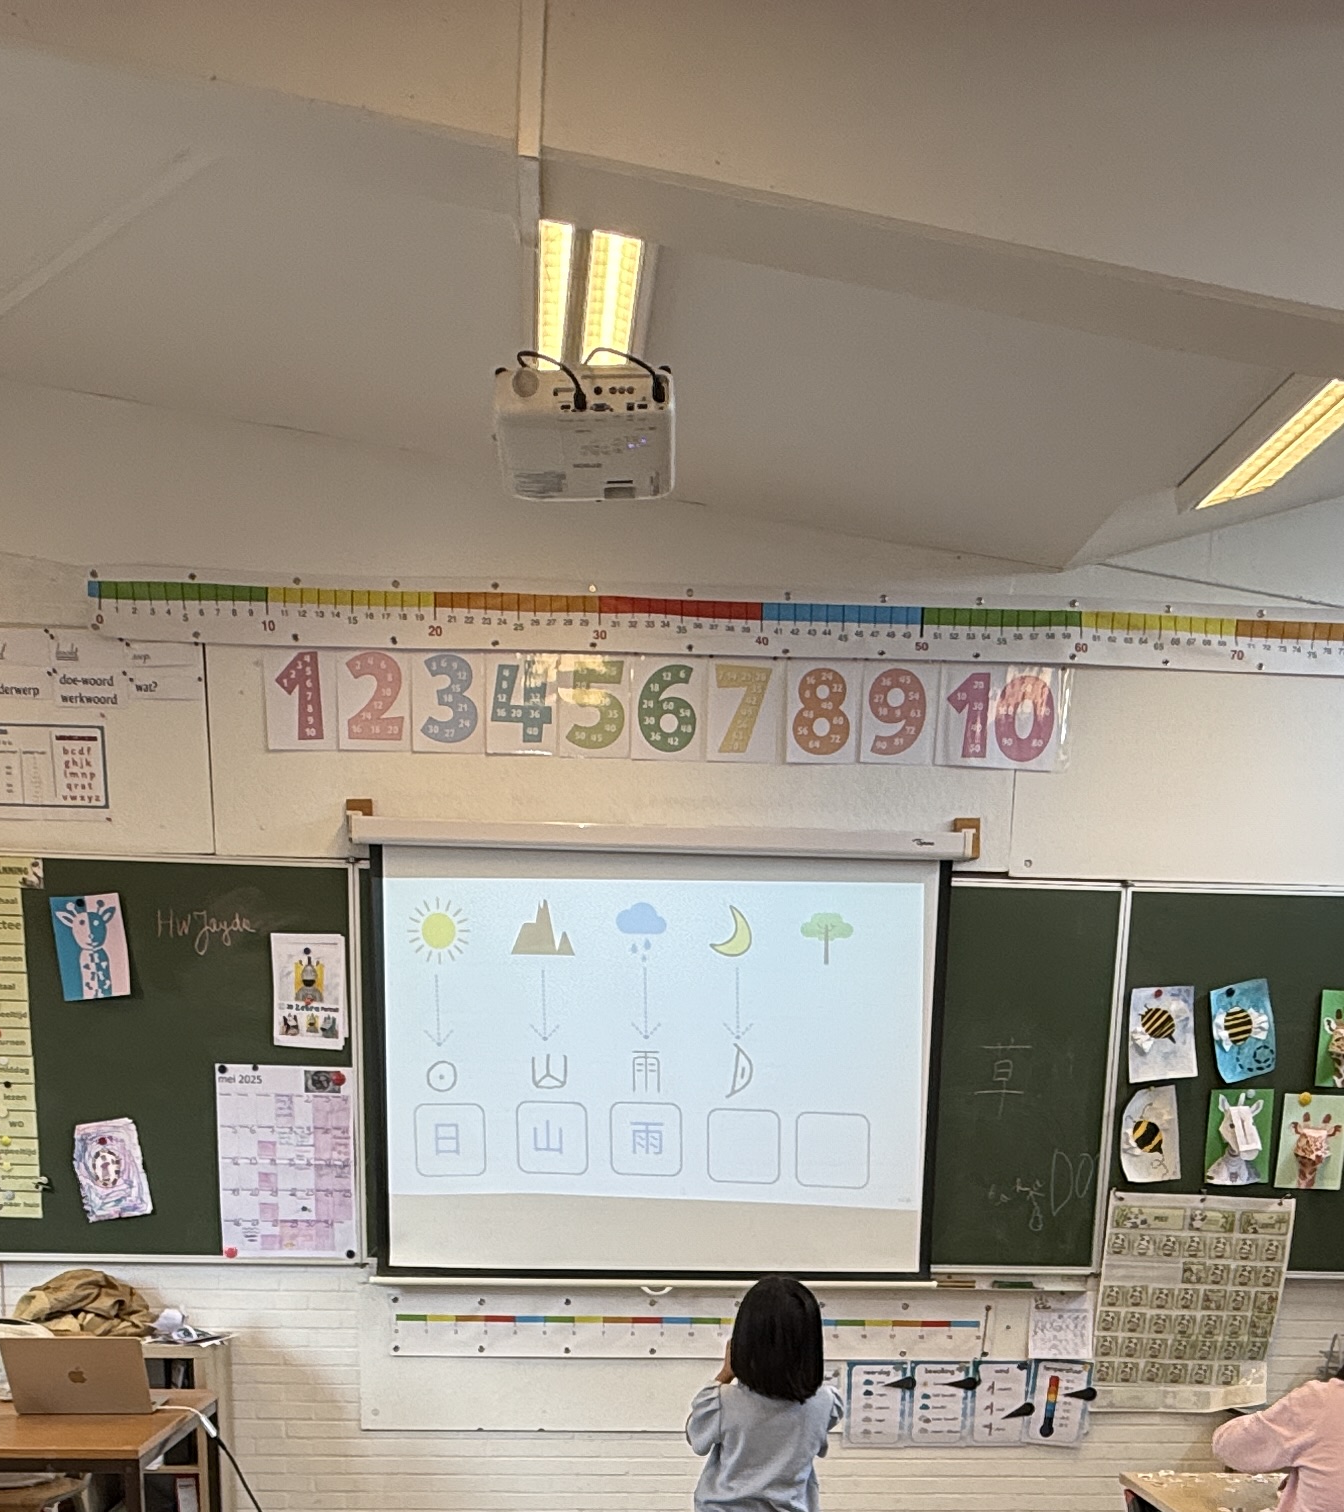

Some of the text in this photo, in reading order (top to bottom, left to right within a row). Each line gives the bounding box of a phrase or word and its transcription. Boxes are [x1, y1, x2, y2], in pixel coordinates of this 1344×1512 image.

[96, 614, 104, 624] 0
[182, 613, 189, 622] 5
[261, 620, 276, 632] 10
[347, 616, 358, 625] 15
[428, 625, 443, 636] 20
[592, 630, 607, 640] 30
[755, 636, 769, 646] 40
[915, 642, 929, 651] 50
[1074, 643, 1088, 653] 60
[1230, 650, 1244, 661] 70
[59, 674, 114, 687] doe-woord
[135, 682, 158, 693] wat?
[60, 692, 118, 705] werkwoord
[275, 651, 1054, 762] 1 2 3 4 5 6 7 8 9 10
[218, 1074, 263, 1085] mei 2025
[434, 1122, 460, 1156] 日
[532, 1120, 564, 1155] 山
[630, 1121, 664, 1155] 雨
